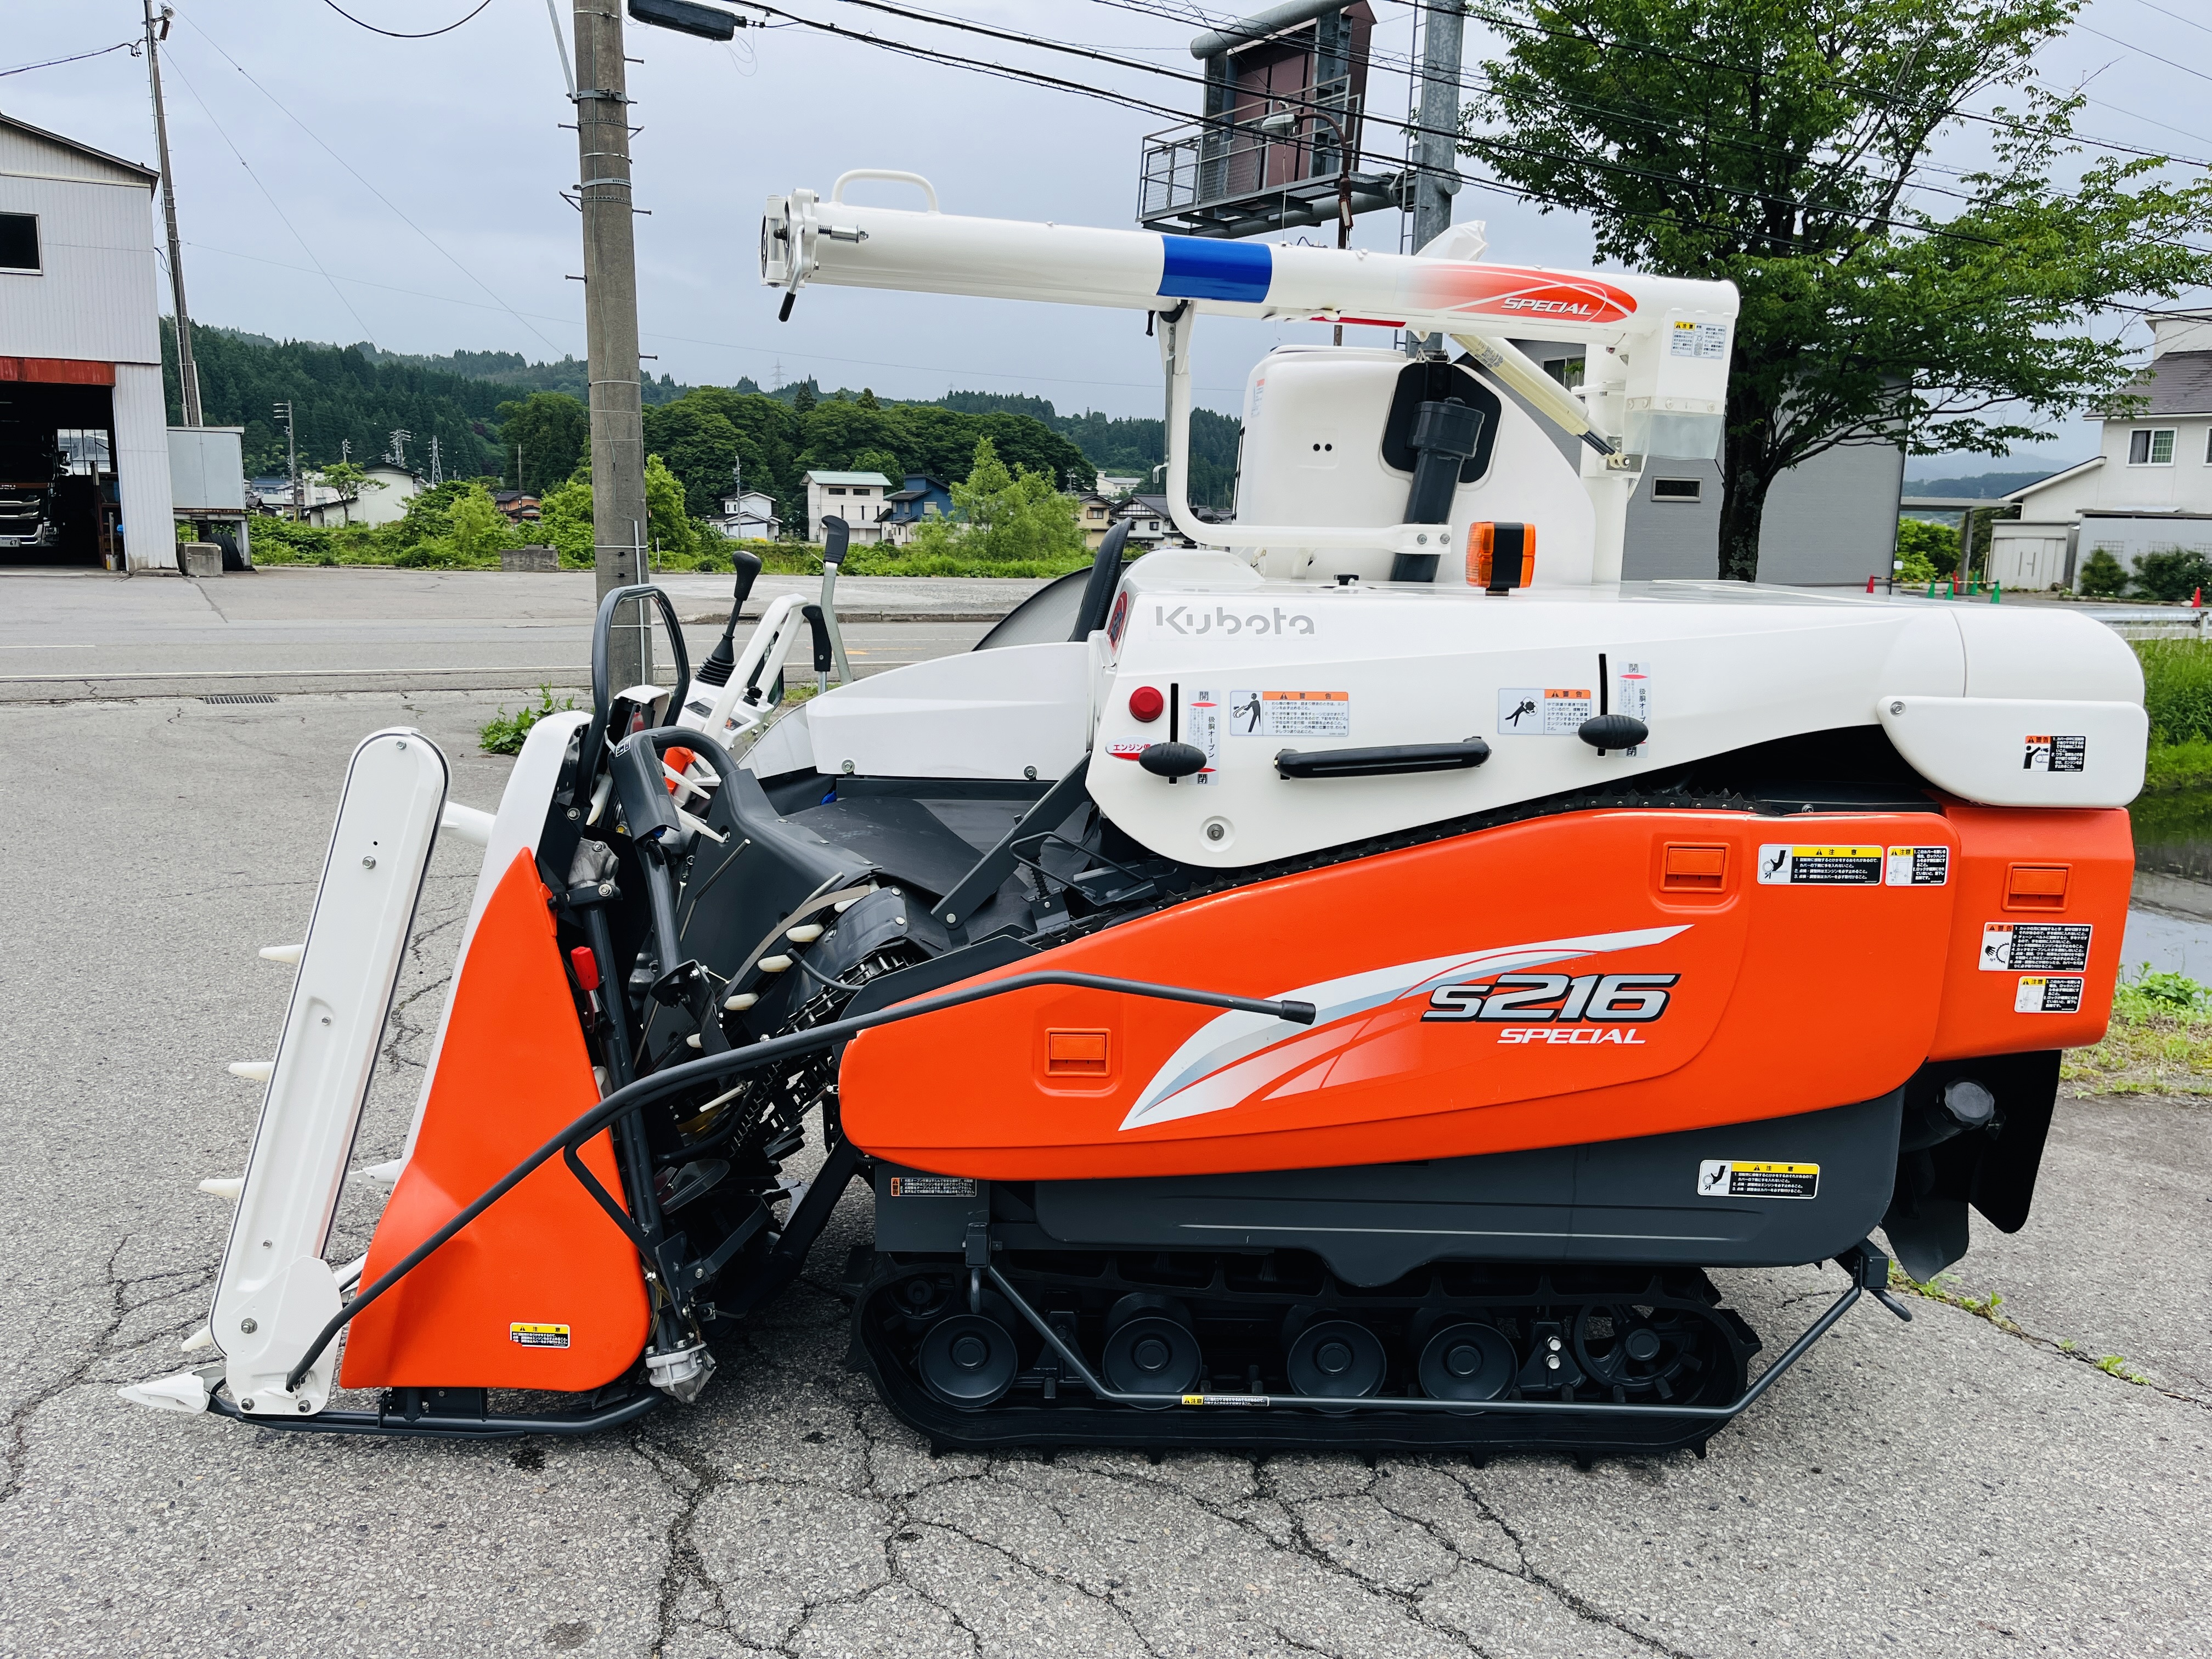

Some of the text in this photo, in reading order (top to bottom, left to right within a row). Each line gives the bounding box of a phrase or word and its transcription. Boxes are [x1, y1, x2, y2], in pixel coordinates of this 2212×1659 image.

[1501, 297, 1592, 315] SPECIAL
[1155, 606, 1315, 635] Kubota
[1628, 663, 1639, 674] 開
[1199, 691, 1209, 701] 開
[1197, 774, 1207, 784] 閉
[1420, 973, 1681, 1023] S216
[1497, 1028, 1646, 1044] SPECIAL
